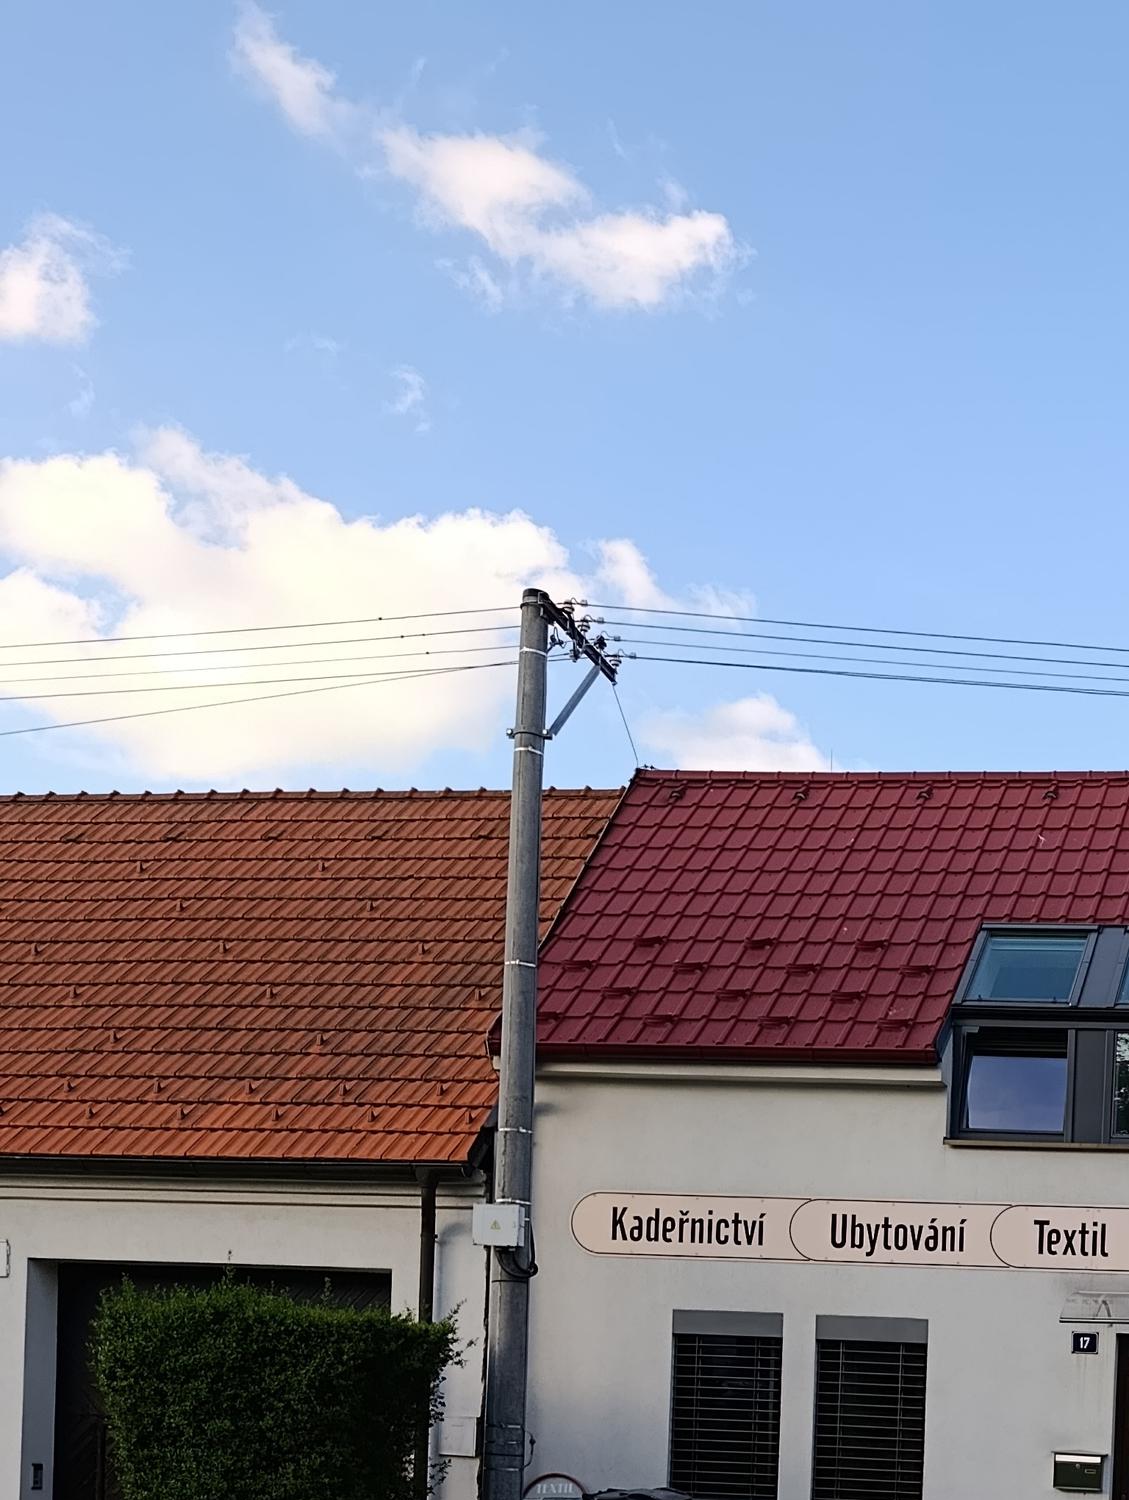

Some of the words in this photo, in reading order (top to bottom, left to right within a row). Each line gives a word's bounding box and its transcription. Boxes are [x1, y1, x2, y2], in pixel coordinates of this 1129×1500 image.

[611, 1206, 767, 1246] Kadeřnictví
[830, 1213, 968, 1257] Ubytování
[1033, 1219, 1109, 1257] Textil
[1079, 1336, 1091, 1349] 17
